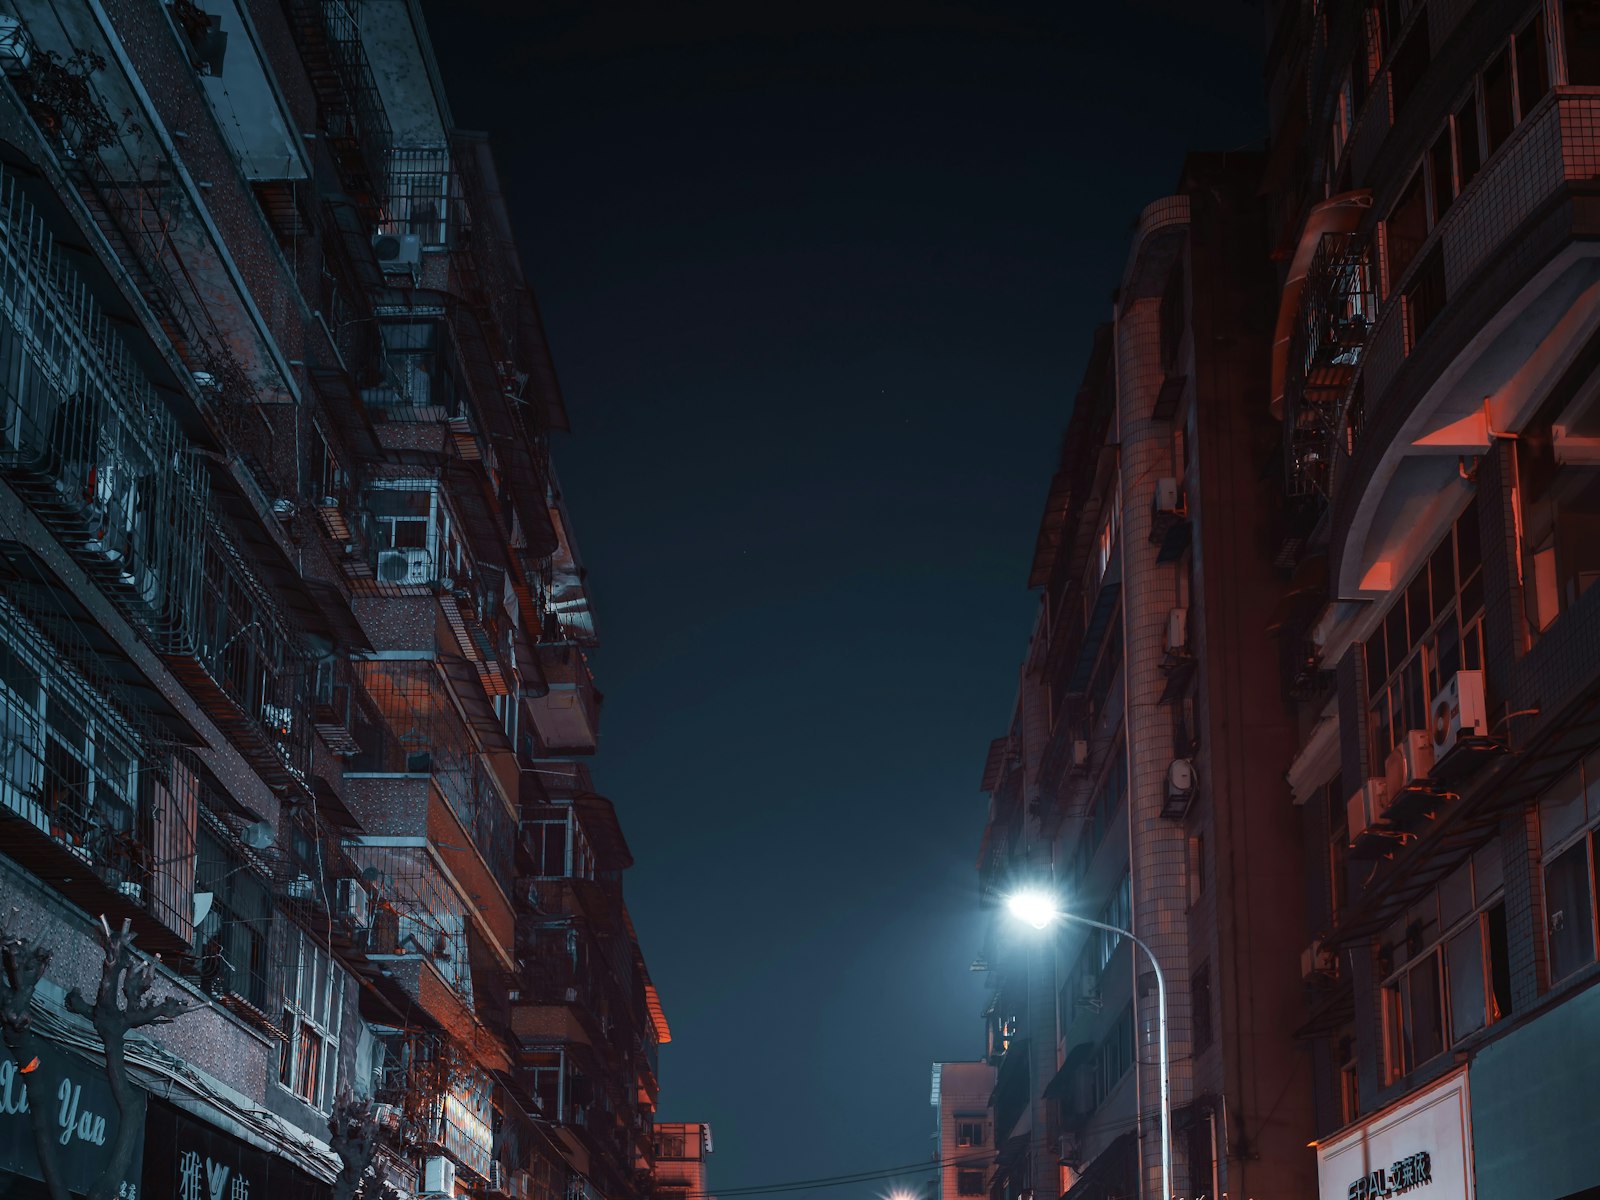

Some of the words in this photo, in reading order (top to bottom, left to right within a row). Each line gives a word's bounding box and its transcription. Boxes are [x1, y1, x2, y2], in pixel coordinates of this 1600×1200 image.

[58, 1077, 106, 1146] Yan
[1390, 1152, 1428, 1191] 艾莱依
